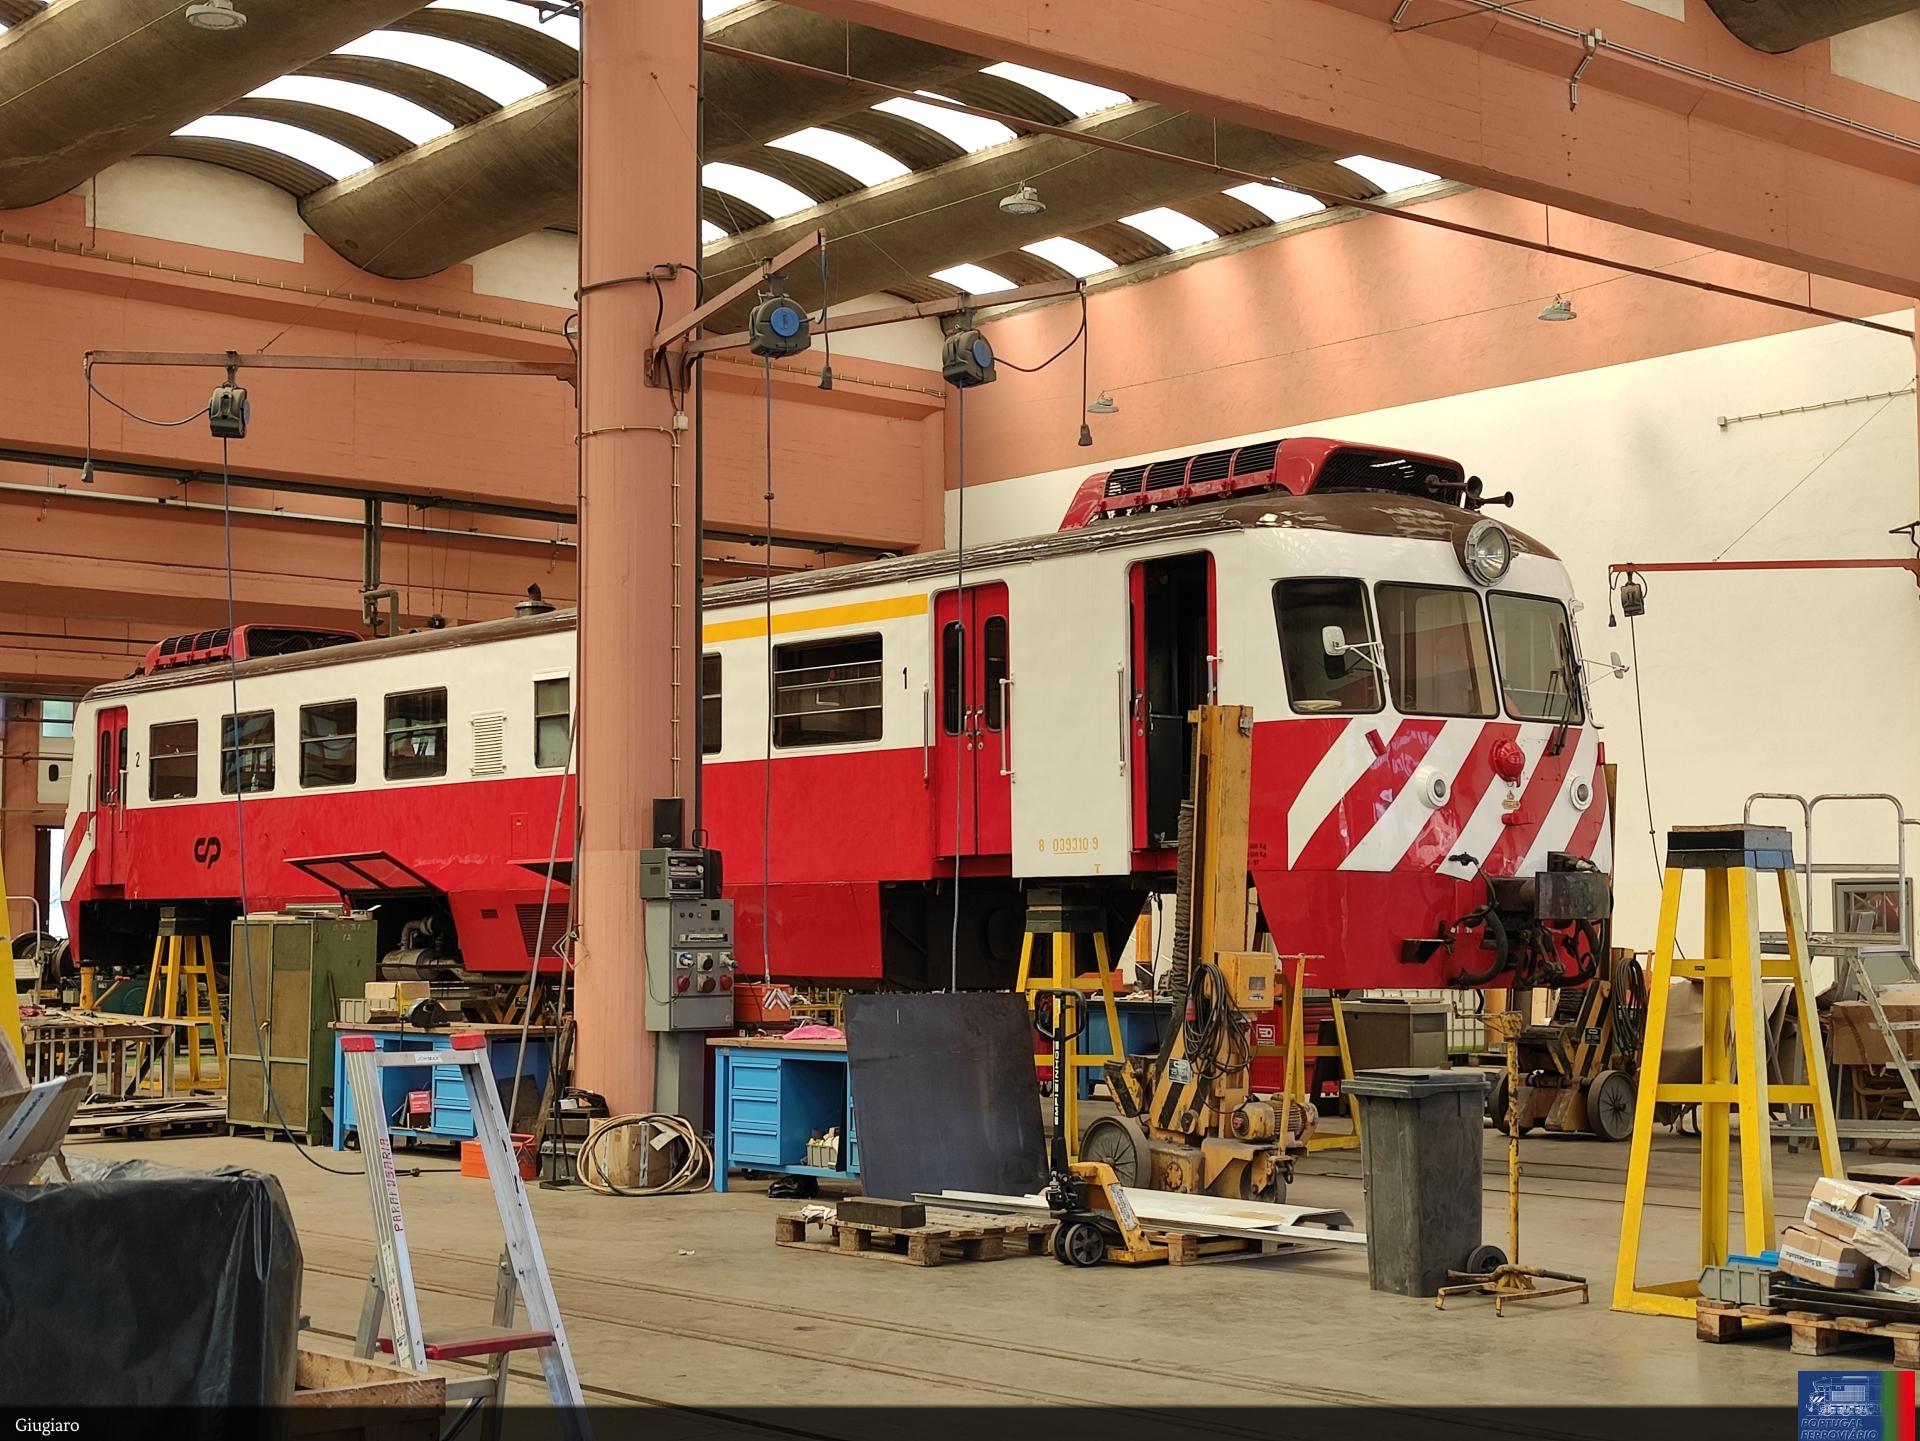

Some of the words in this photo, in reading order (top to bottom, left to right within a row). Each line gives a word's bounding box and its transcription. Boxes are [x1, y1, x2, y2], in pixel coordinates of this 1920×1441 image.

[902, 667, 908, 690] 1
[135, 751, 141, 768] 2
[1038, 838, 1045, 852] 8
[1052, 837, 1089, 852] 039310
[1092, 836, 1099, 850] 9
